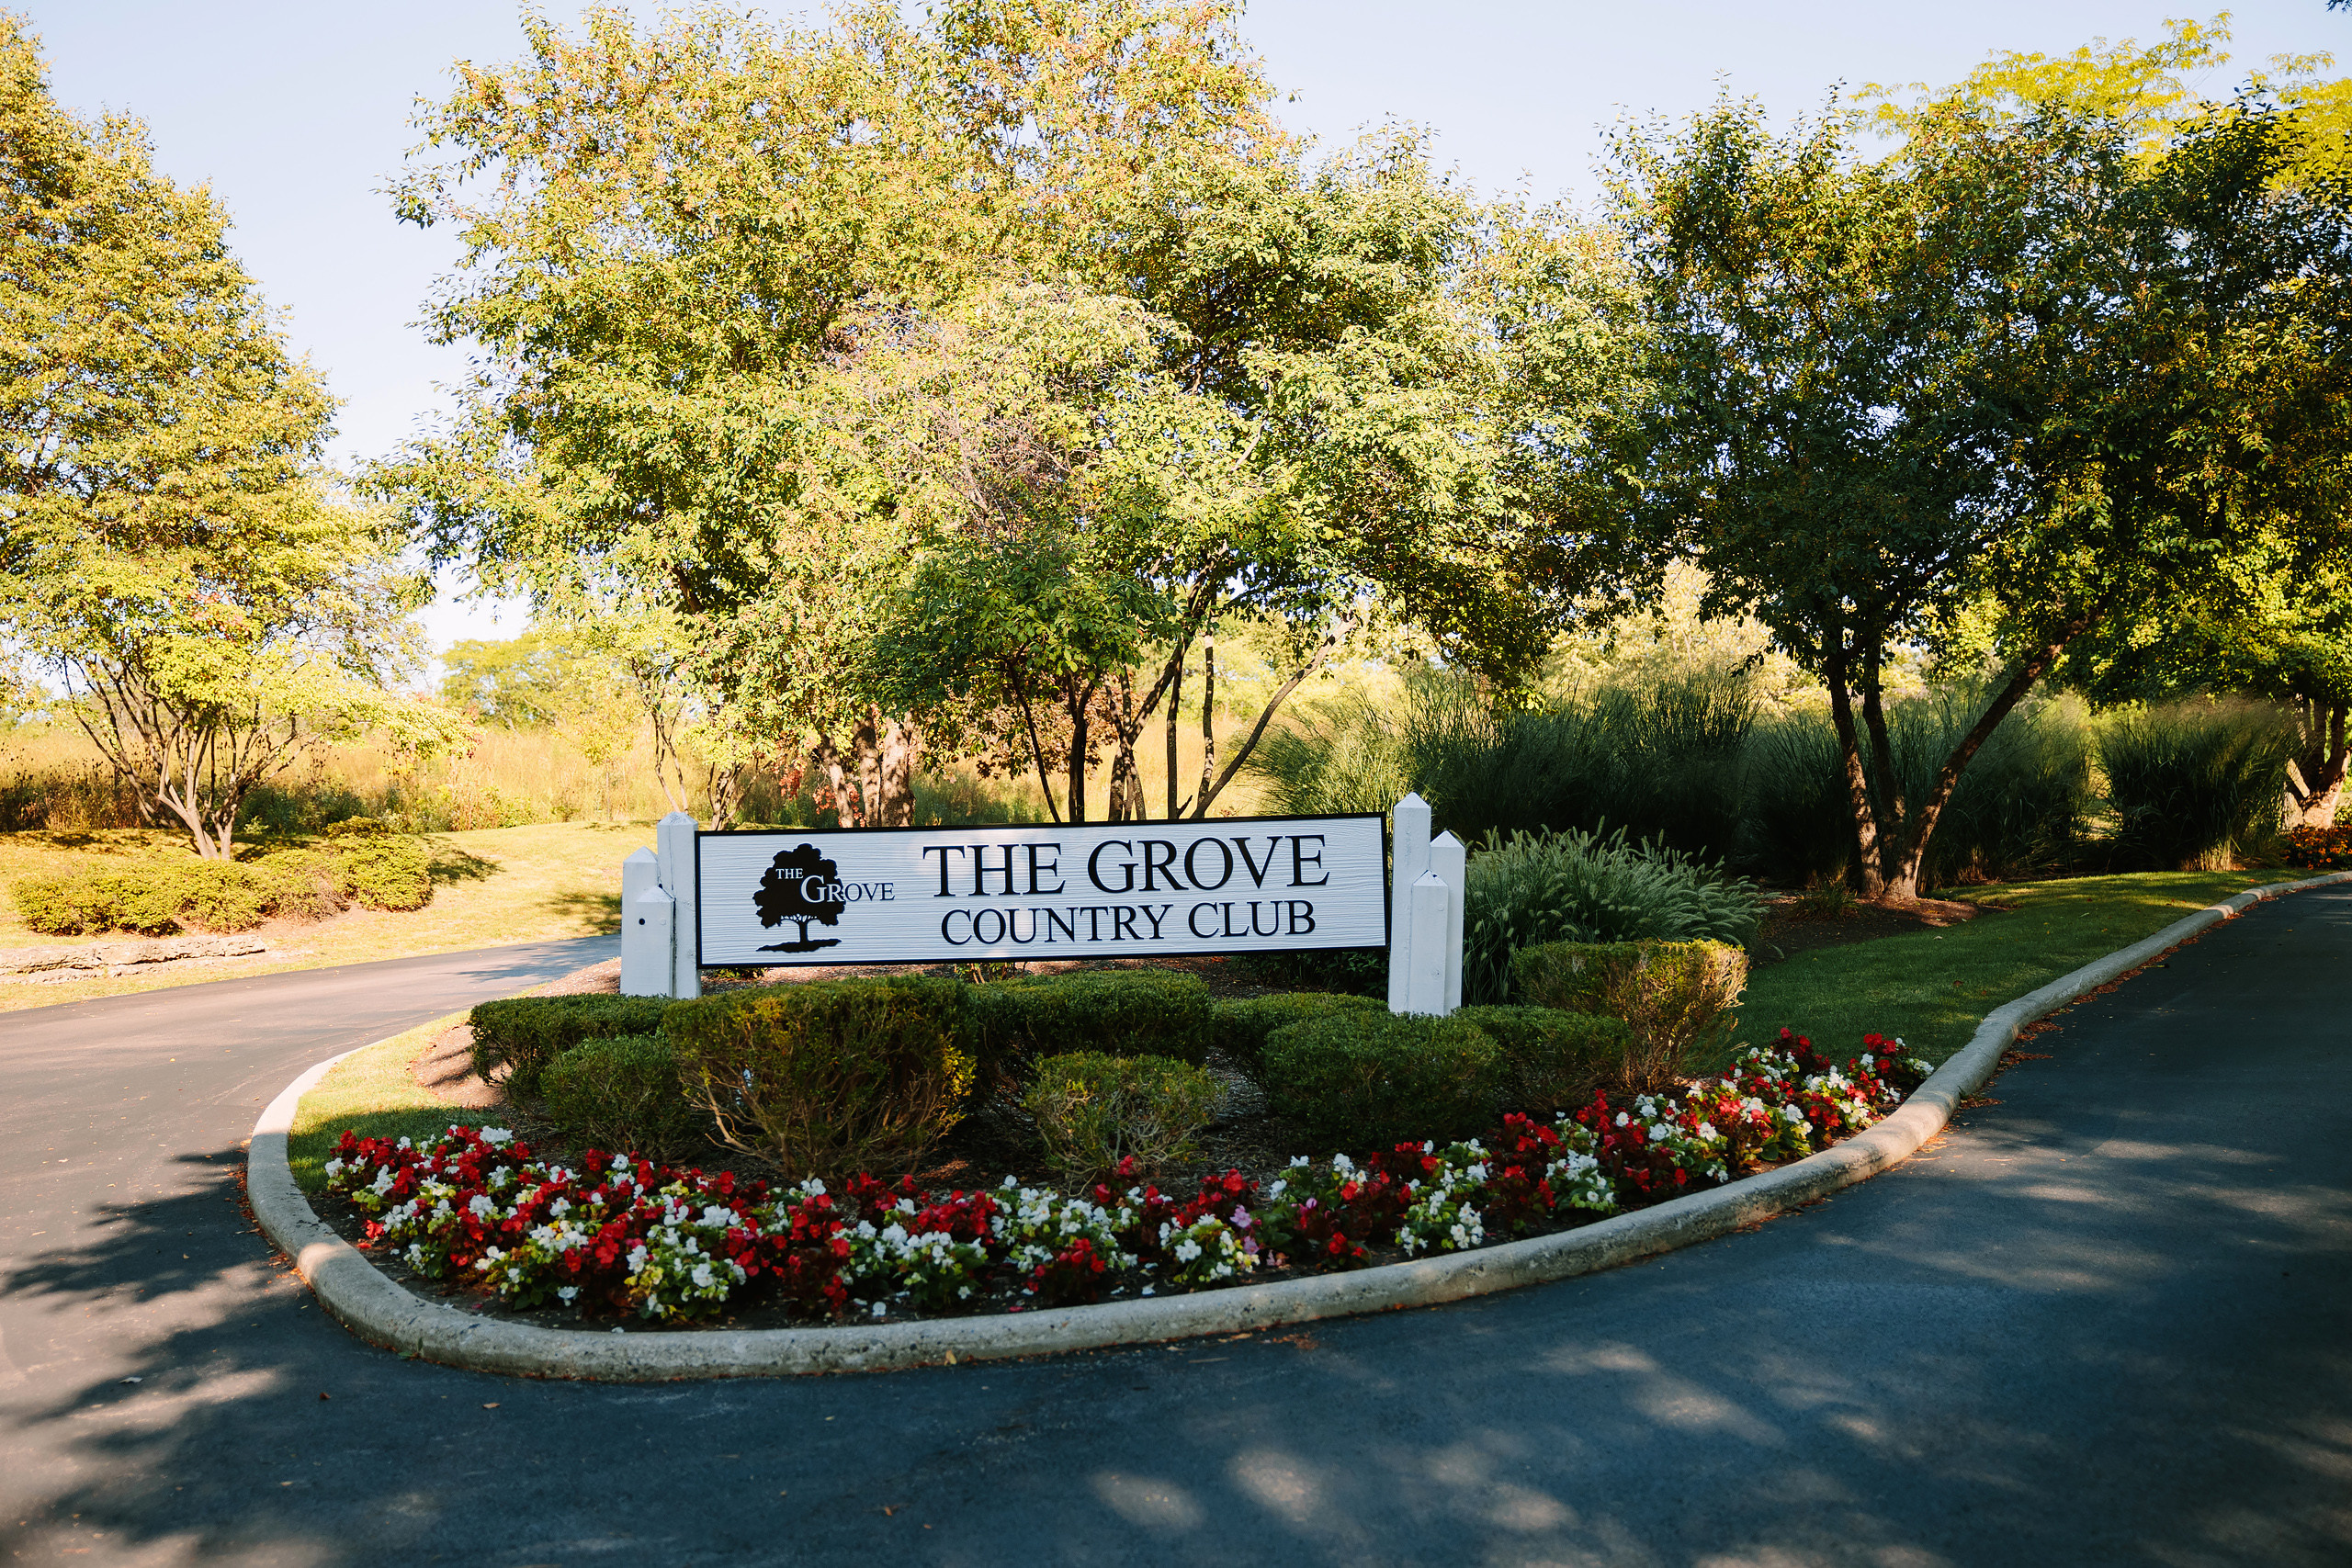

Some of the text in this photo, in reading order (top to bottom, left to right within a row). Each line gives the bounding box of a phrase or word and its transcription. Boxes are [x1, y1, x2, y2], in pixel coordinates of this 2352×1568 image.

[775, 867, 804, 880] THE
[922, 835, 1330, 897] THE GROVE
[801, 874, 895, 904] GROVE
[941, 900, 1317, 945] COUNTRY CLUB
